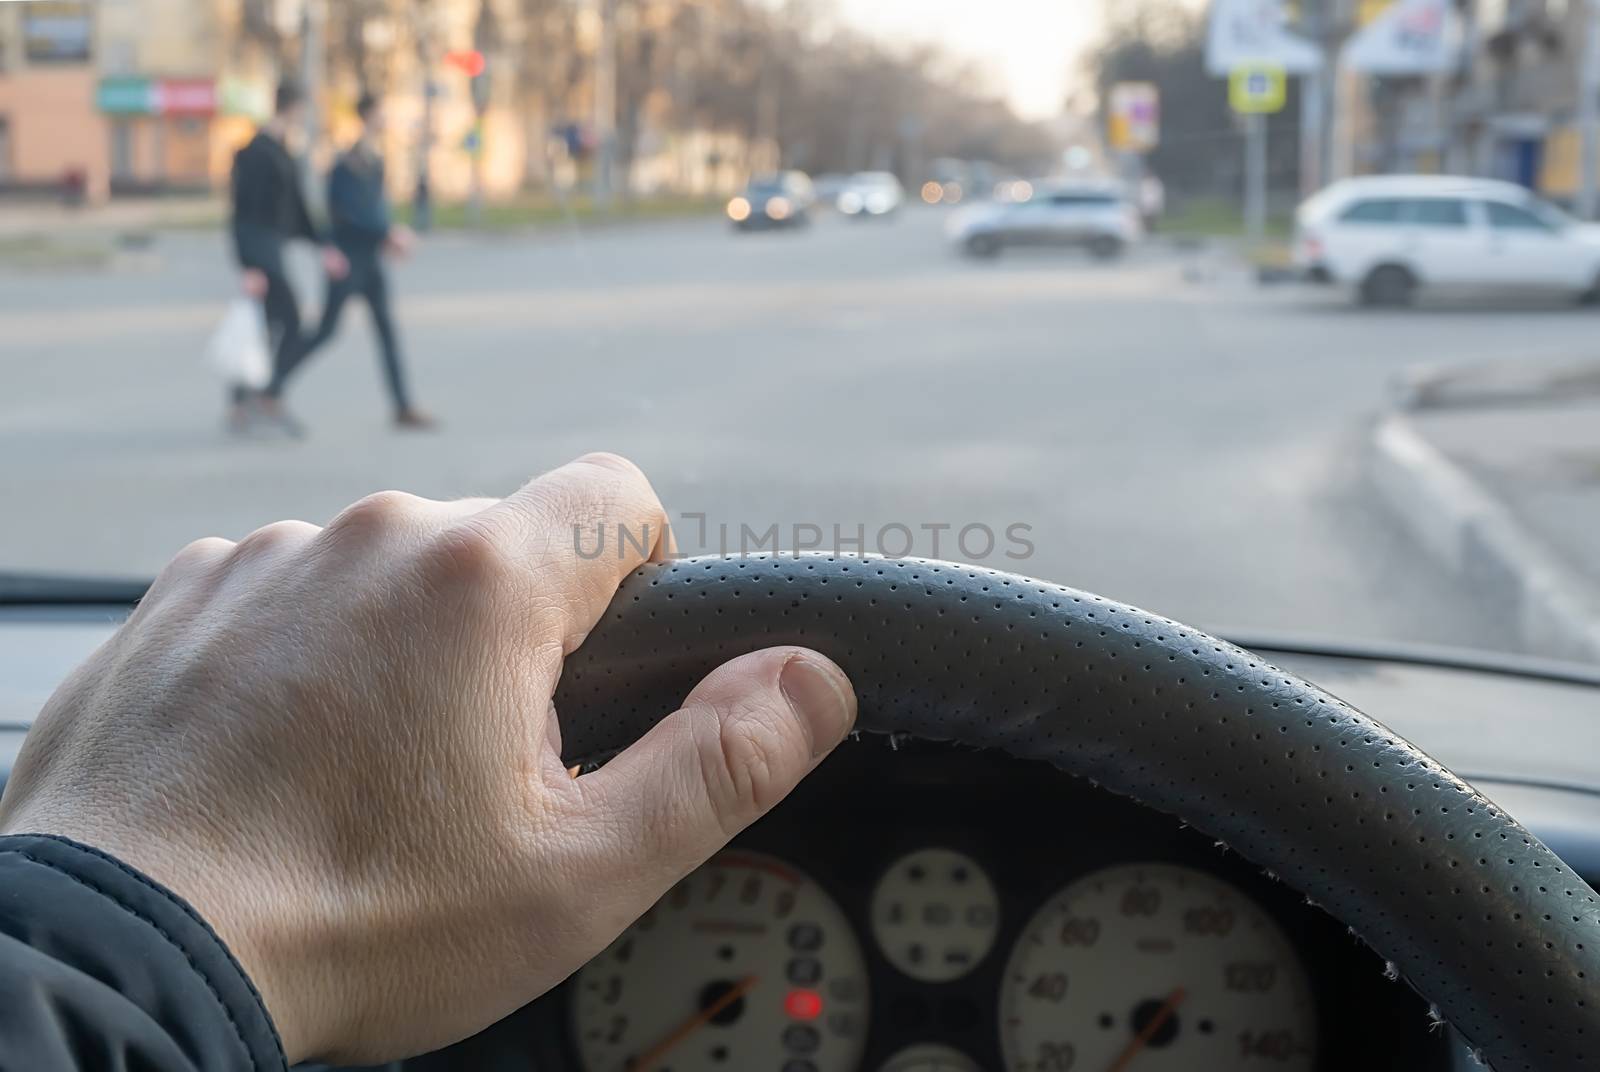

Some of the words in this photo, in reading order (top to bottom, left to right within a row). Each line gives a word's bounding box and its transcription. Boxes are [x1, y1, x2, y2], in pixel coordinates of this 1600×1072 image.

[1185, 906, 1233, 937] 100
[1028, 973, 1068, 1003] 40
[1226, 963, 1277, 992] 120
[1037, 1041, 1075, 1072] 20
[1237, 1029, 1293, 1061] 140
